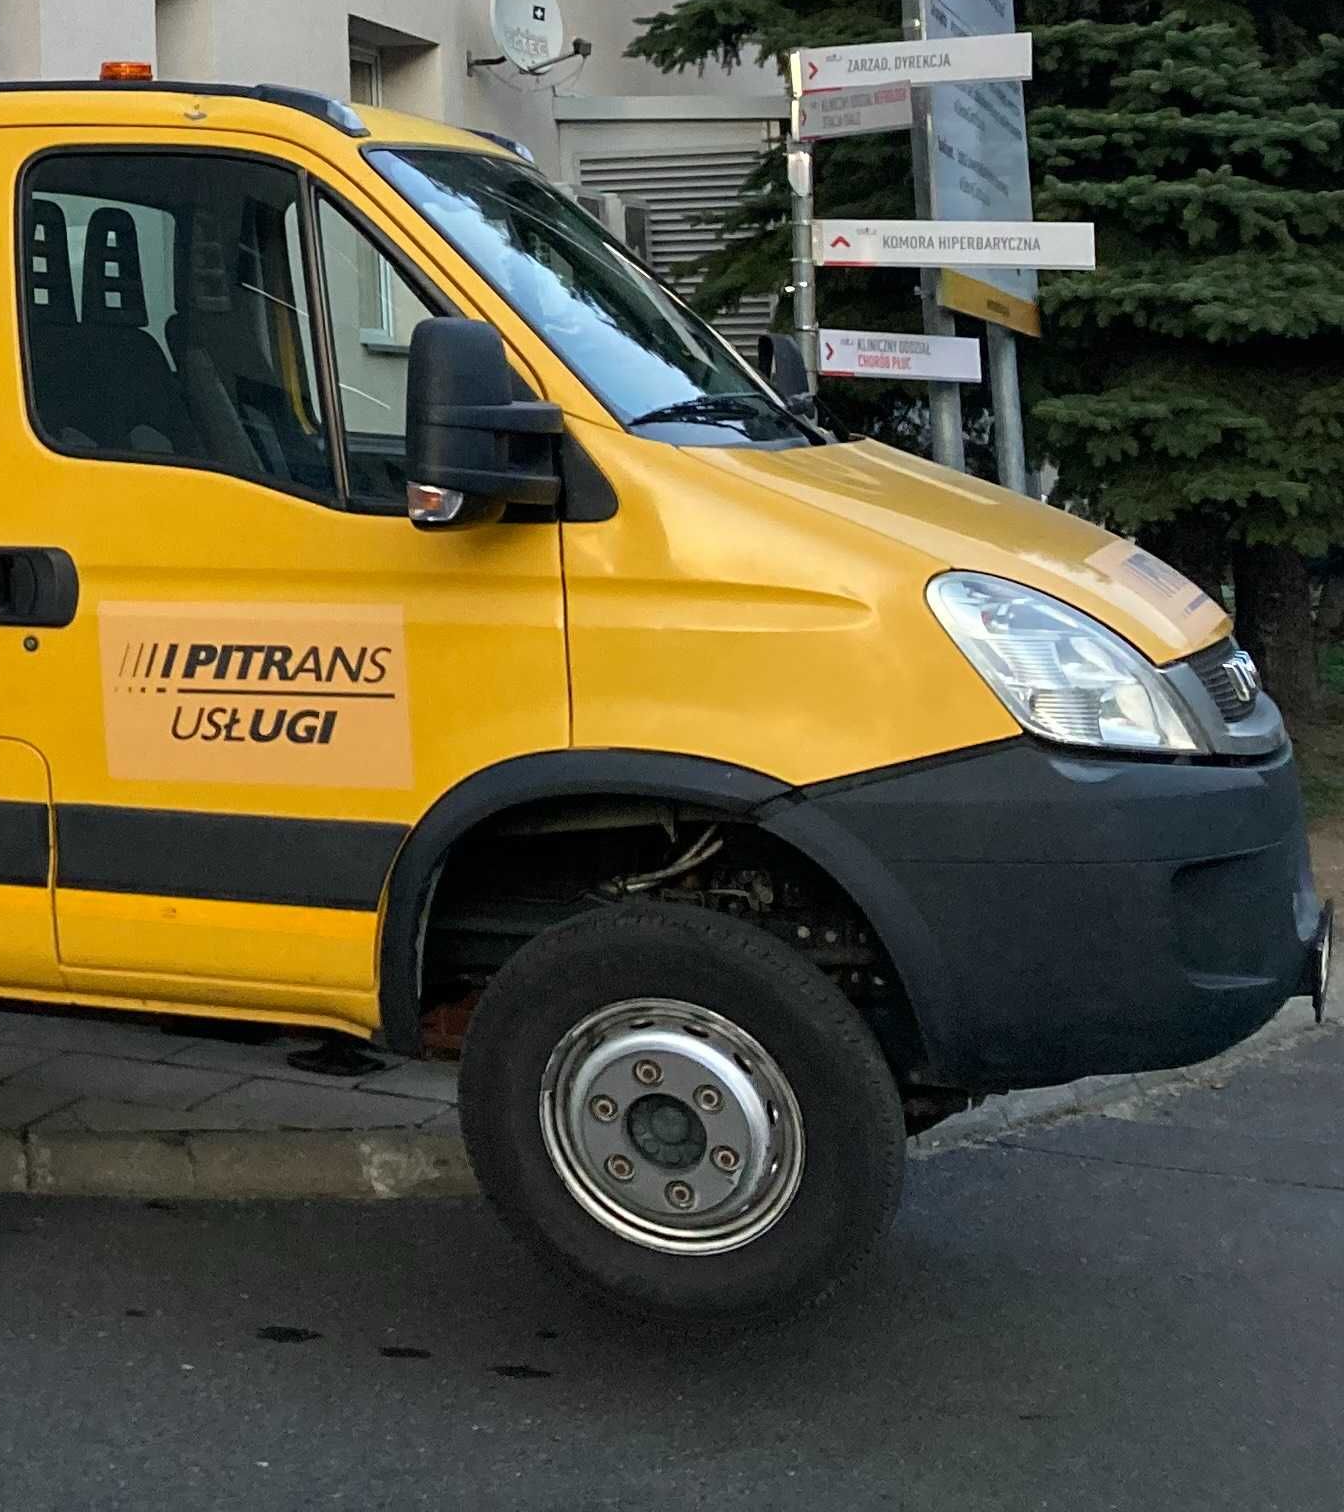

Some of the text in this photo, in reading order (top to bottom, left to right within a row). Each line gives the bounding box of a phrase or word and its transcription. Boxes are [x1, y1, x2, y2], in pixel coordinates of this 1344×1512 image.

[894, 53, 951, 71] DYREKCJA
[882, 234, 1041, 252] KOMORA HIPERBARYCZNA
[182, 642, 392, 684] PITRANS
[171, 706, 338, 744] USŁUGI
